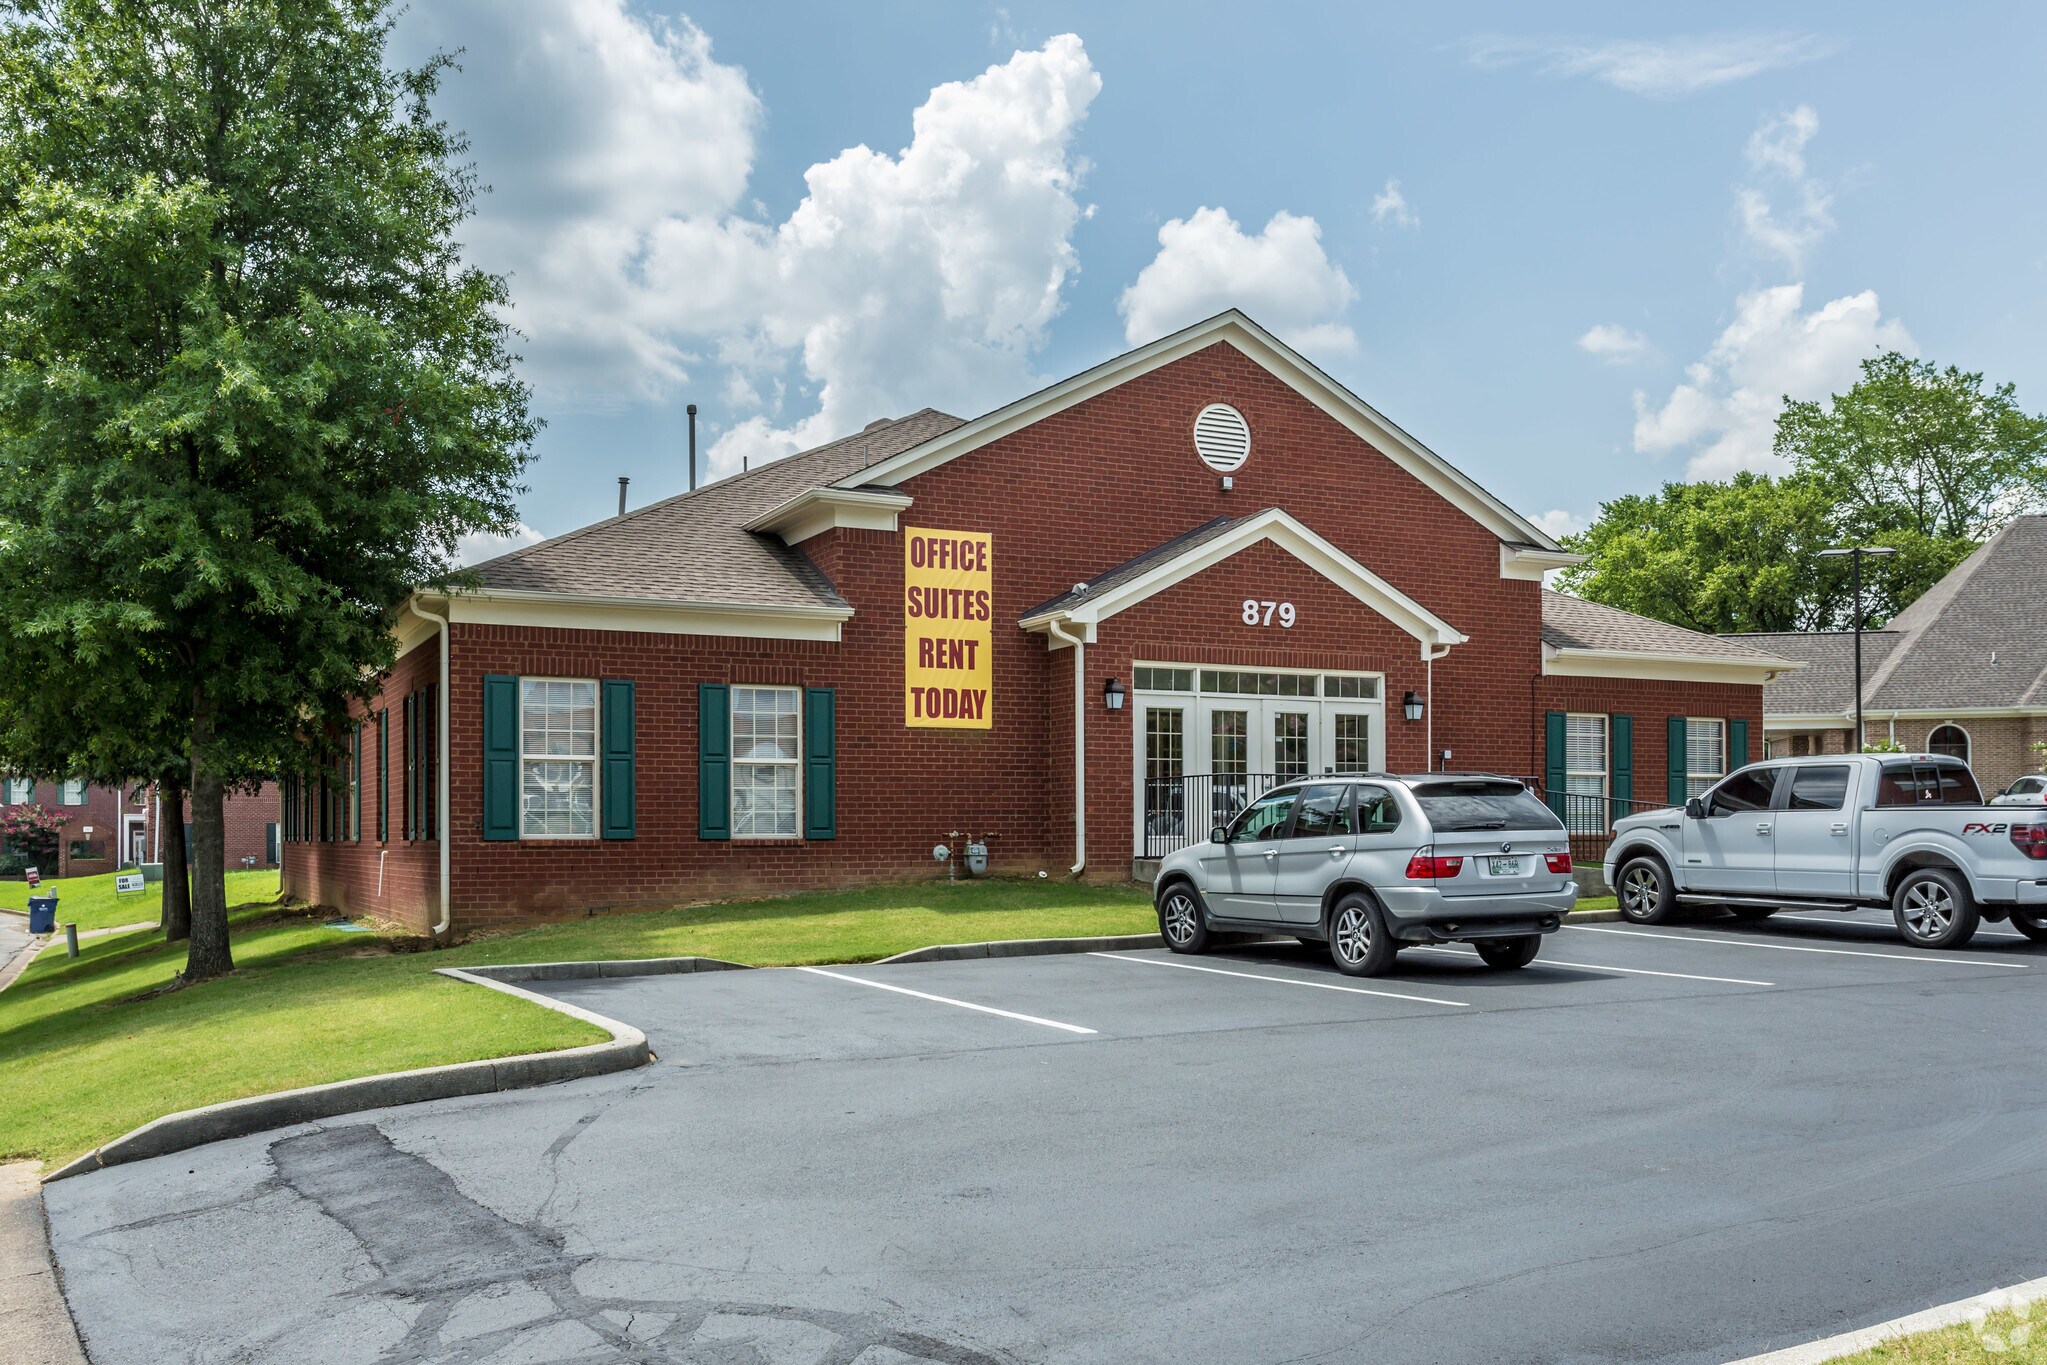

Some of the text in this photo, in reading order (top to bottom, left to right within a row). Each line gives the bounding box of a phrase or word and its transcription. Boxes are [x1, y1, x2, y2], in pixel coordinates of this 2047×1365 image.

[911, 536, 987, 572] OFFICE
[907, 586, 990, 621] SUITES
[1242, 600, 1296, 628] 879
[919, 637, 979, 670] RENT
[911, 687, 987, 720] TODAY
[1963, 823, 2008, 833] FX2
